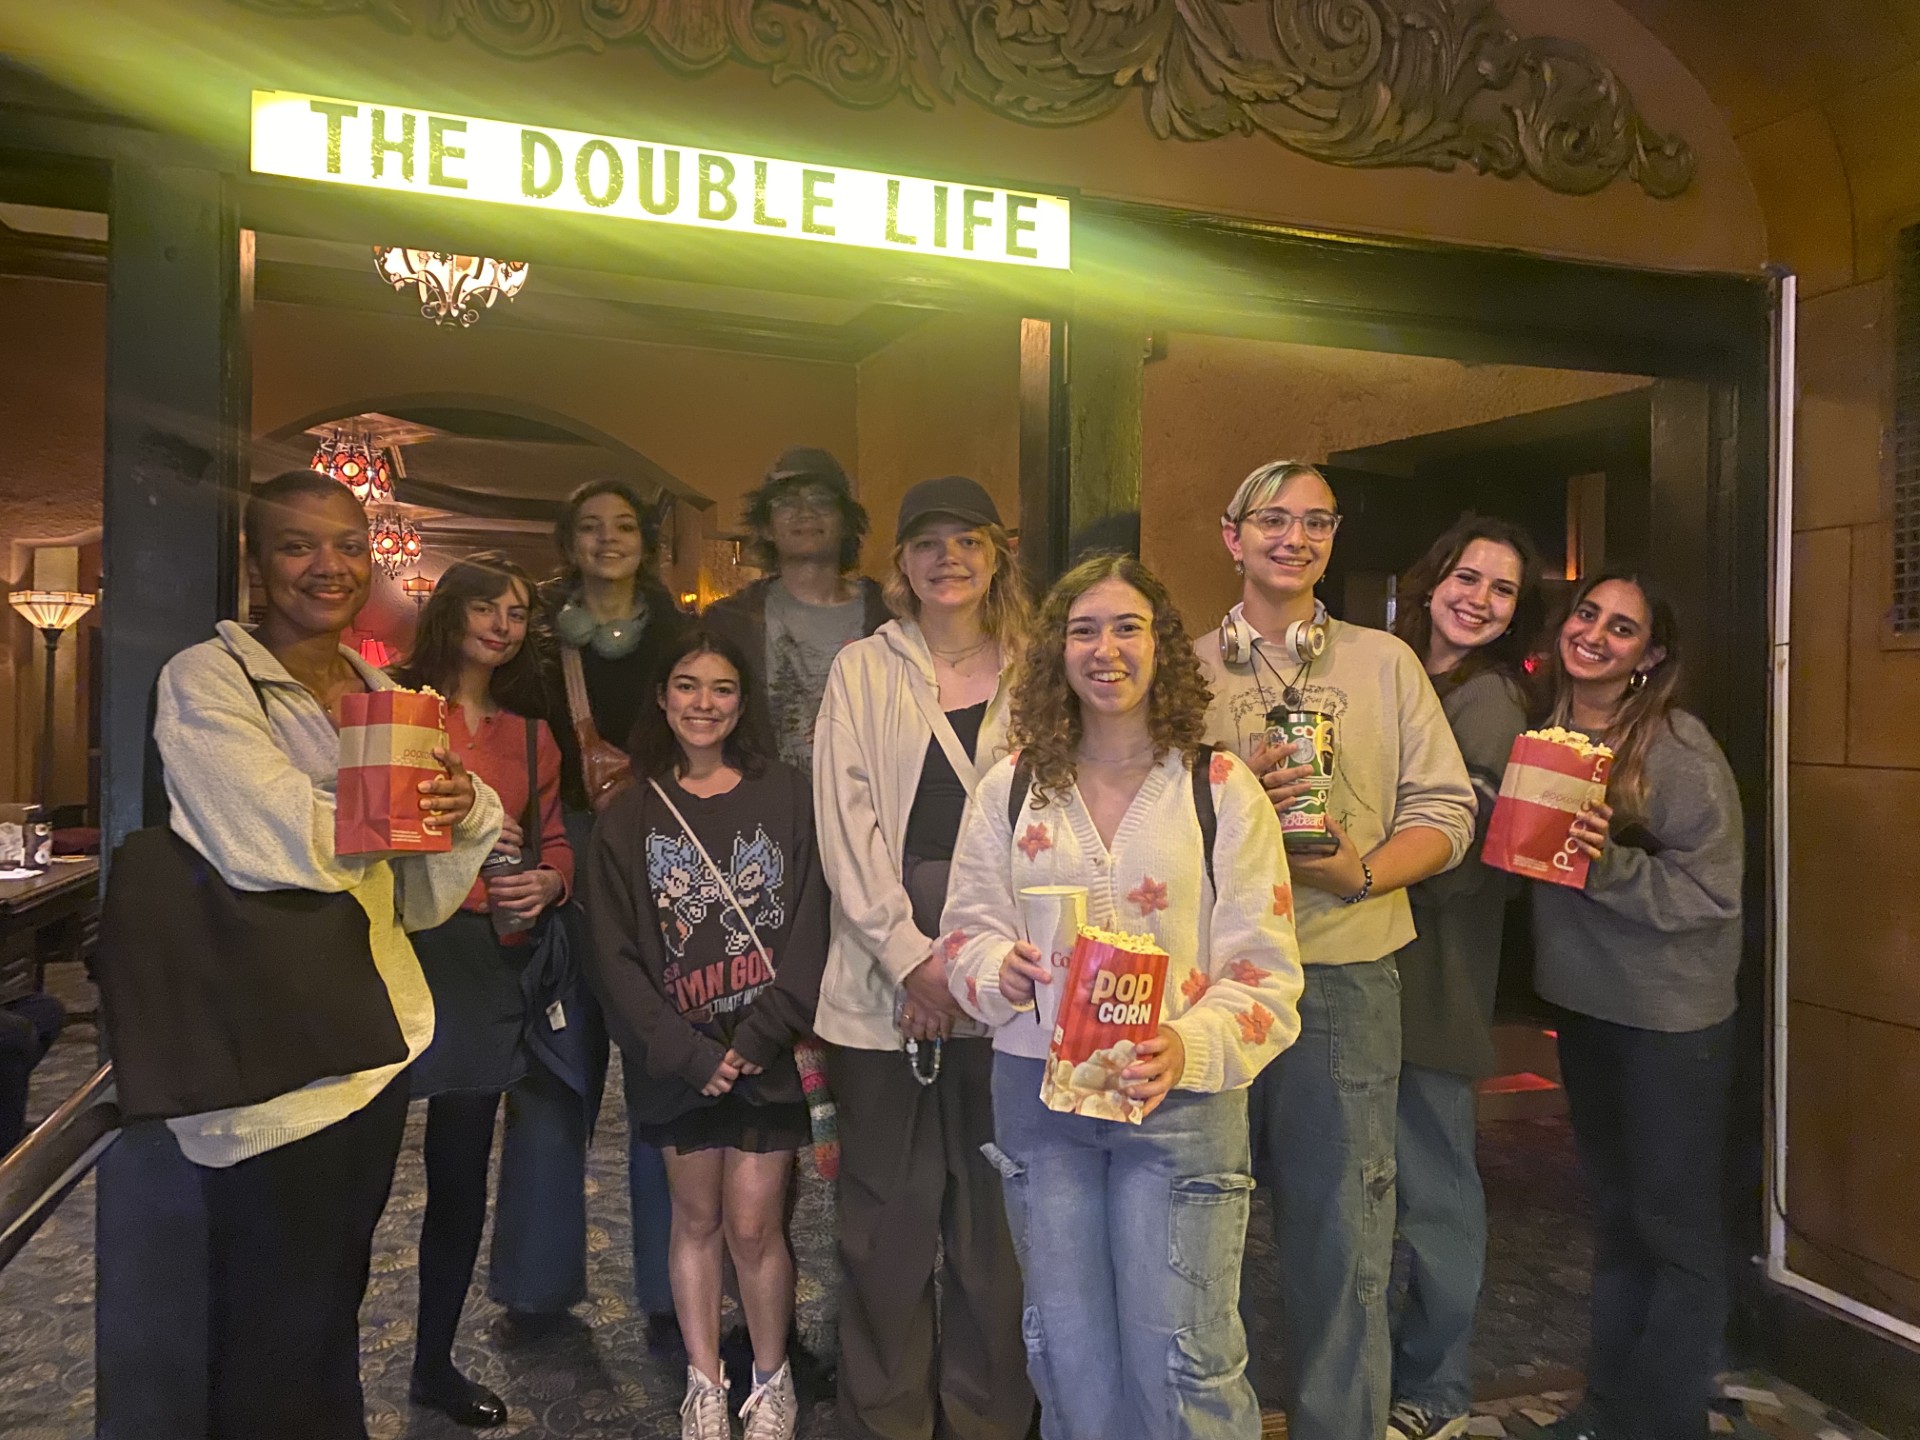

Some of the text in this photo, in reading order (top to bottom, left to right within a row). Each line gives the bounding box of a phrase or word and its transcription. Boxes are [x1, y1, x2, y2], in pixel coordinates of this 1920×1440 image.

[309, 98, 1039, 260] THE DOUBLE LIFE
[1050, 951, 1071, 968] Co
[1090, 968, 1154, 1006] POP
[1098, 1001, 1152, 1025] CORN
